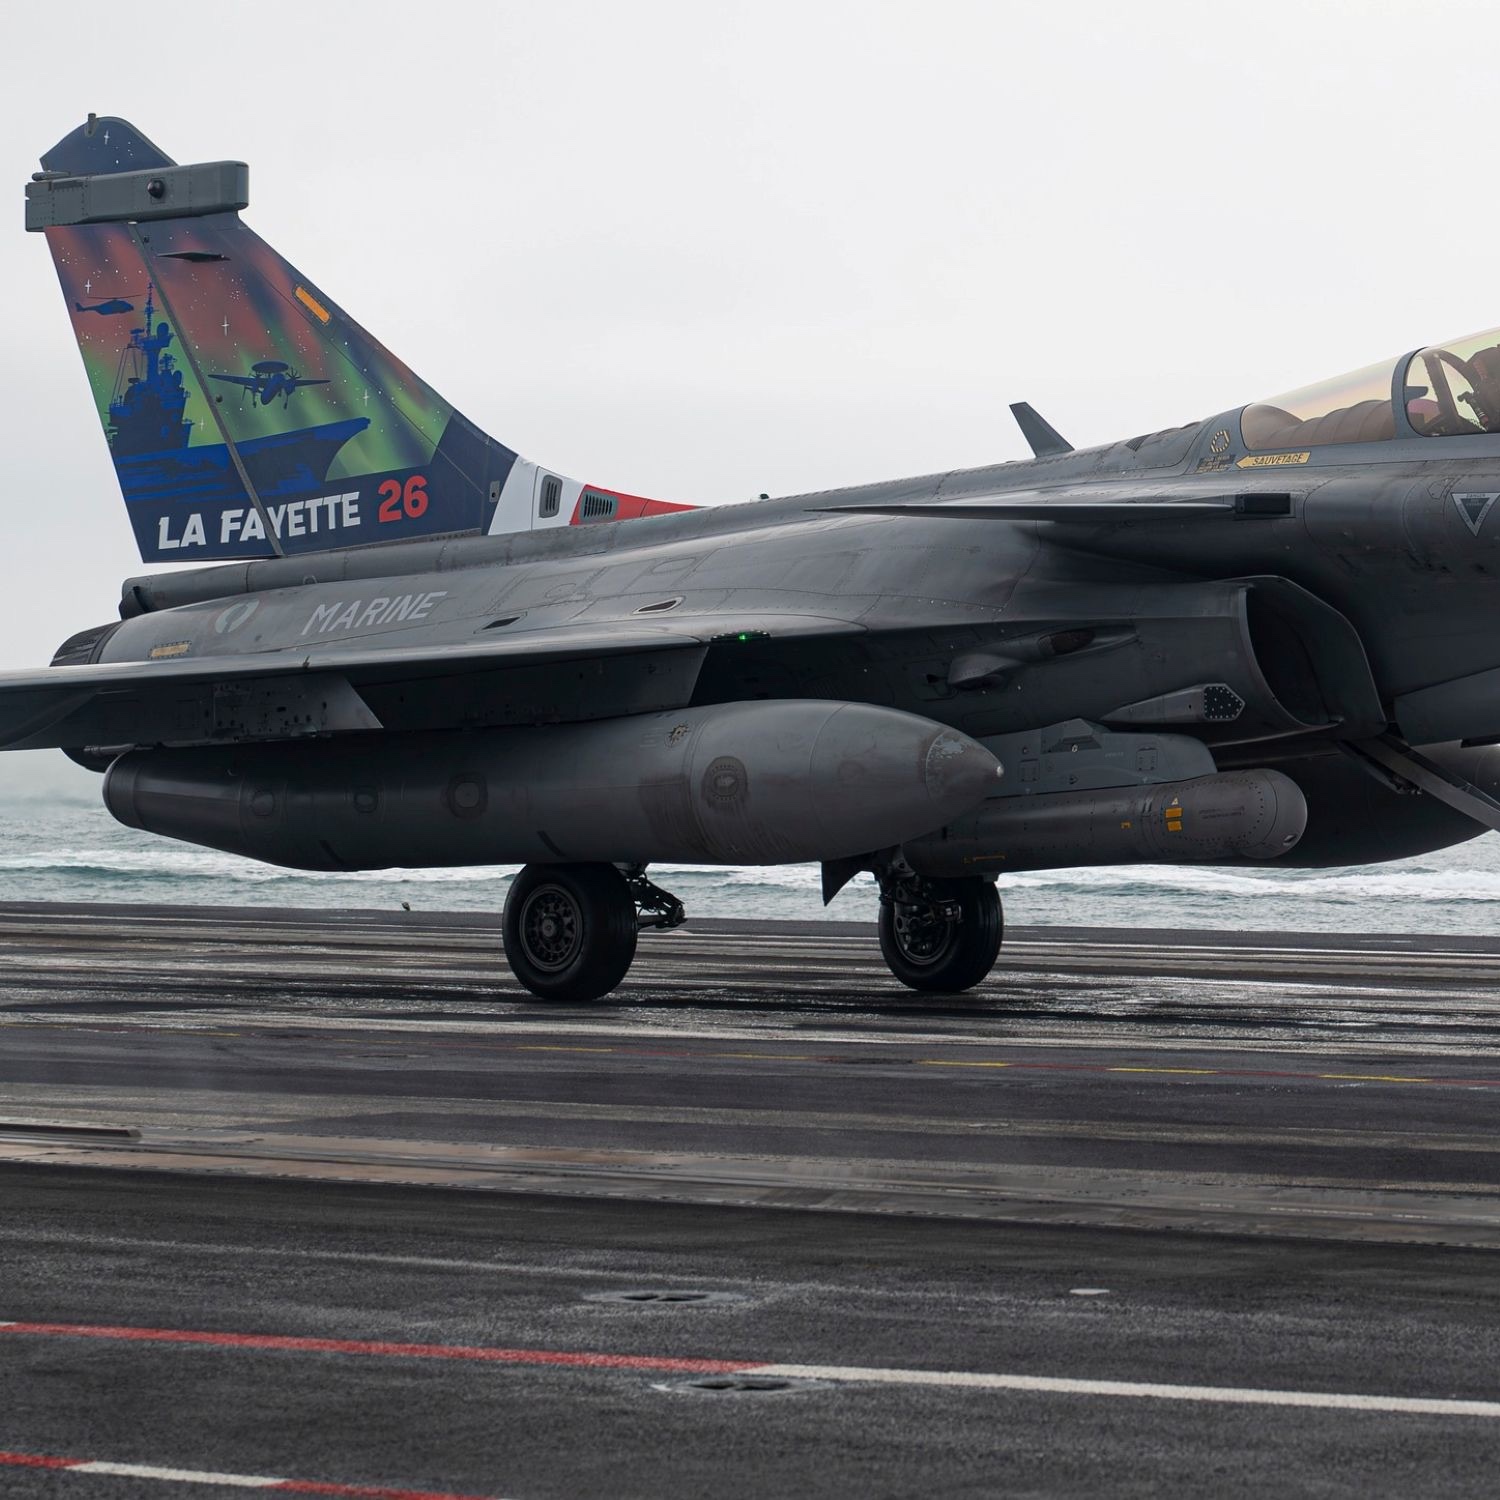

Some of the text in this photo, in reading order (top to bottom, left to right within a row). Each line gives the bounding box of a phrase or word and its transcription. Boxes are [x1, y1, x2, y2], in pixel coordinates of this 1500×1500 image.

[1252, 454, 1303, 465] SAUVETAGE
[158, 475, 429, 549] LA FAYETTE 26
[301, 591, 448, 635] MARINE
